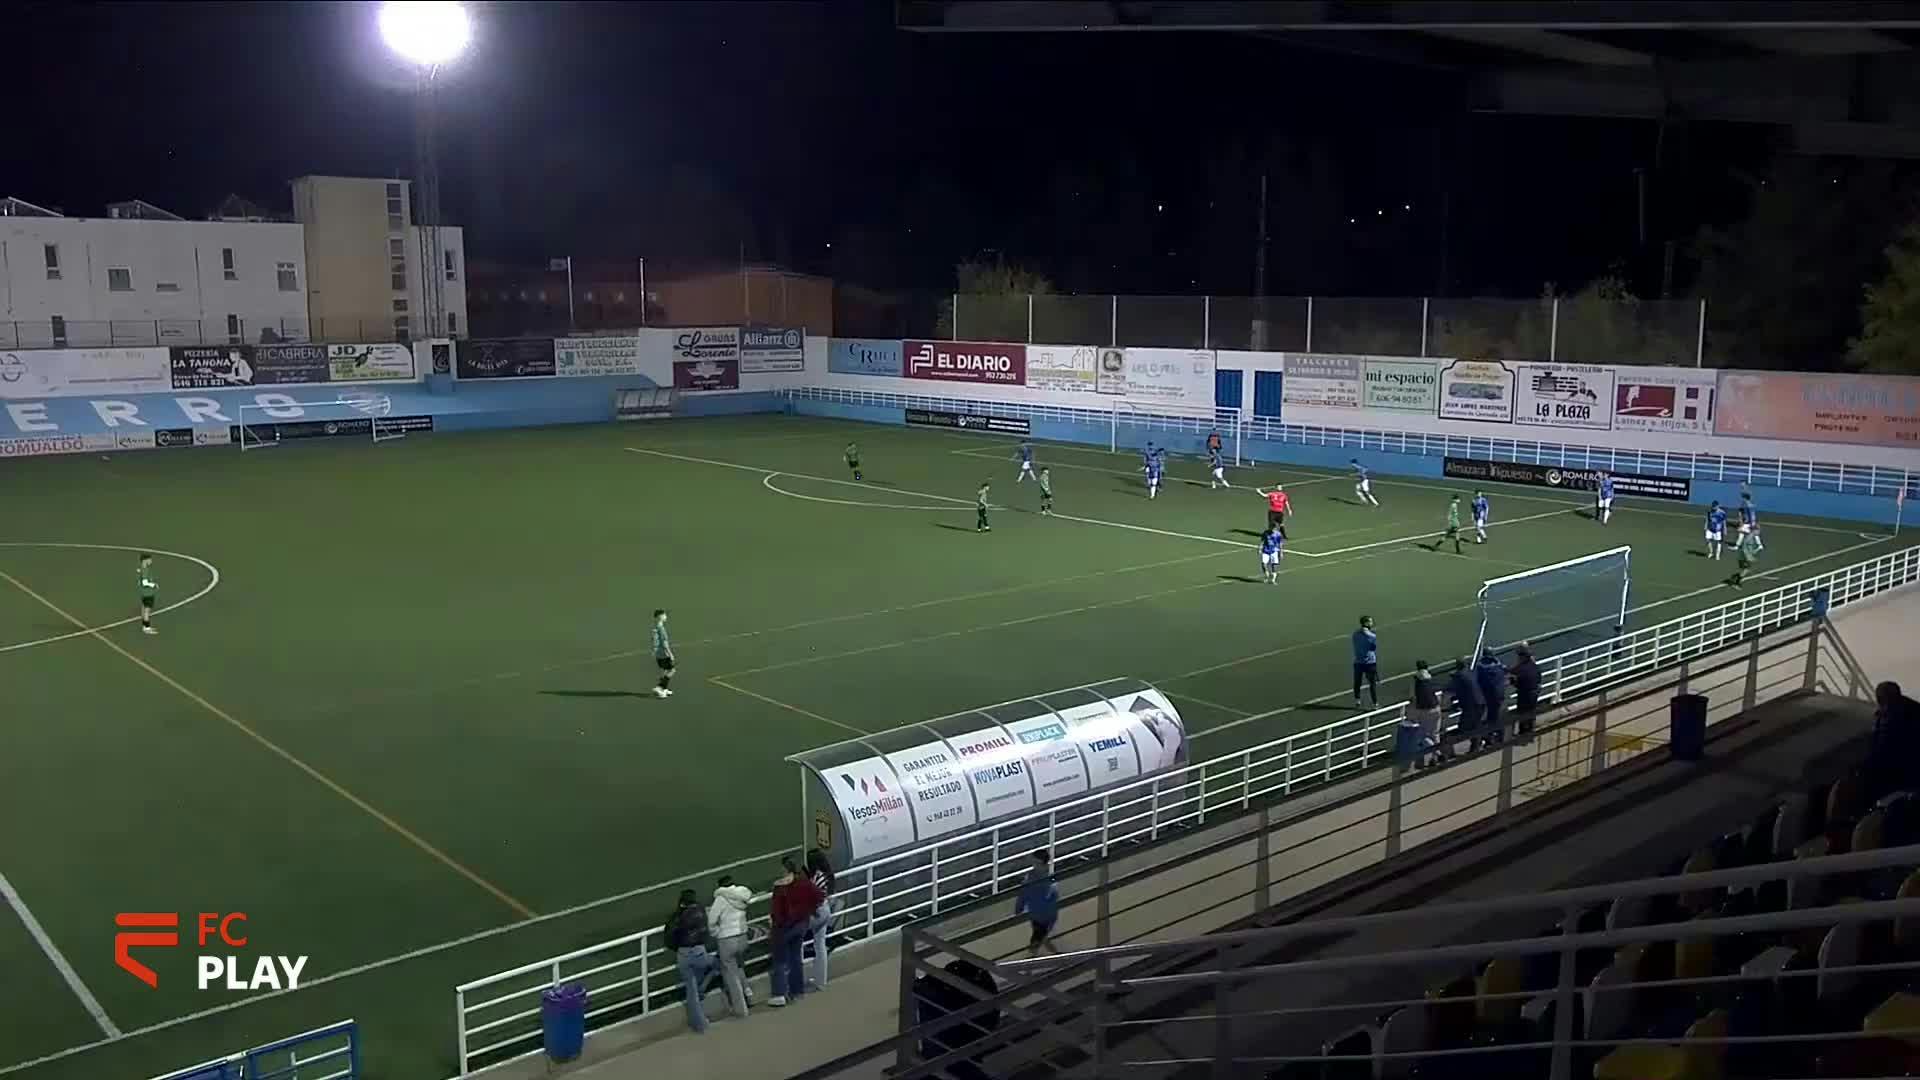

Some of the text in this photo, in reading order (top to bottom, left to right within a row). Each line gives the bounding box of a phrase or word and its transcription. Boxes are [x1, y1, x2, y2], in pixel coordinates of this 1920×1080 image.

[744, 332, 782, 345] Allianz
[333, 346, 356, 355] JD
[173, 359, 186, 368] LA
[938, 353, 1010, 372] EL DIARIO
[1366, 371, 1382, 382] mi
[1385, 373, 1434, 385] espacio
[1536, 403, 1590, 420] LA PLAZA
[0, 441, 84, 456] OMUALDO
[959, 736, 1011, 757] PROMILL
[1088, 735, 1127, 754] YEMILL
[903, 752, 949, 773] GARANTIZA
[926, 767, 953, 783] MEJOR
[974, 760, 1024, 785] NOVAPLAST
[918, 780, 962, 802] RESULTADO
[848, 796, 904, 821] YesosMillán
